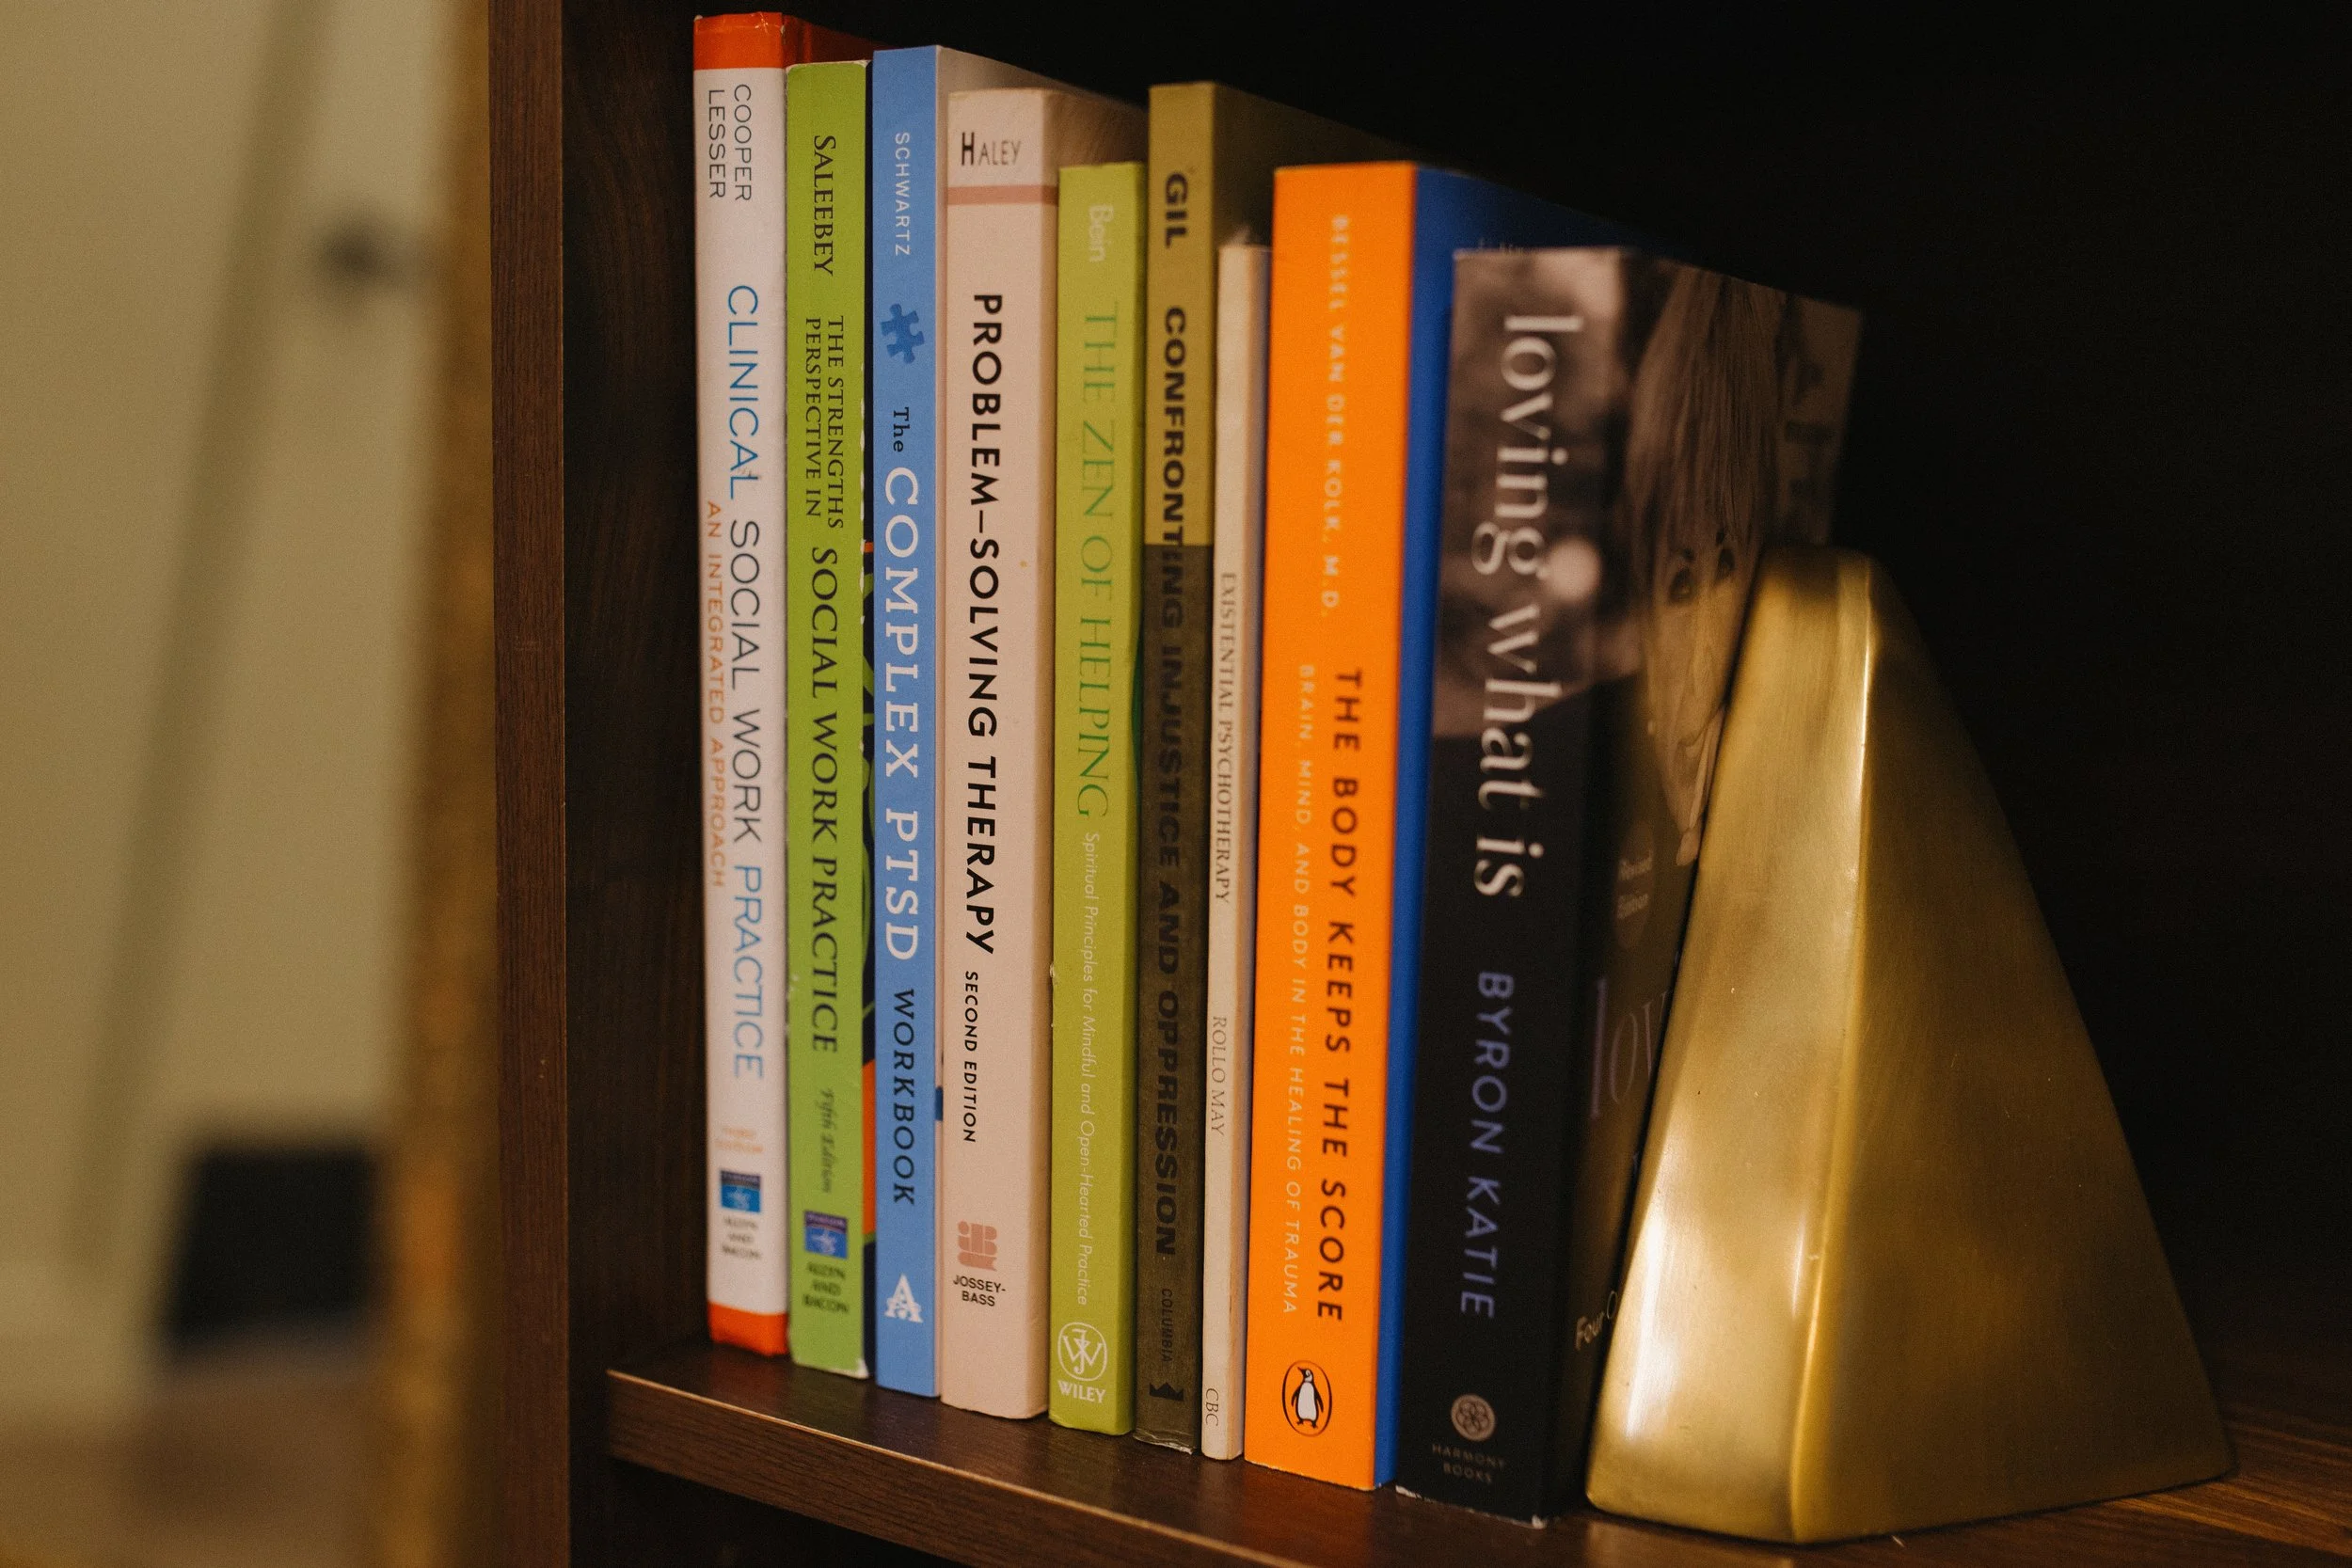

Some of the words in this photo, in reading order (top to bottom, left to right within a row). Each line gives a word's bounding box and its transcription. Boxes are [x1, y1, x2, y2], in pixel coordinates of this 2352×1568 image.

[707, 88, 726, 198] LESSER
[733, 84, 752, 201] COOPER
[961, 132, 1021, 166] HALEY
[813, 135, 835, 275] SALEEBEY
[894, 133, 912, 257] SCHWARTZ
[1089, 204, 1112, 261] Bein
[1165, 173, 1187, 246] GIL
[827, 316, 845, 365] THE
[1081, 302, 1118, 404] THE
[1327, 325, 1345, 382] VAN
[728, 285, 759, 499] CLINICAL
[805, 317, 822, 480] PERSPECTIVE
[890, 407, 911, 452] The
[1326, 395, 1343, 445] DER
[827, 376, 845, 529] STRENGTHS
[1081, 420, 1115, 517] ZEN
[1161, 308, 1186, 632] CONFRONTING
[1471, 315, 1582, 579] loving
[707, 500, 723, 538] AN
[805, 488, 822, 518] IN
[730, 519, 761, 689] SOCIAL
[1080, 535, 1113, 603] OF
[707, 554, 725, 723] INTEGRATED
[811, 546, 838, 698] SOCIAL
[884, 467, 918, 778] COMPLEX
[1219, 572, 1236, 714] EXISTENTIAL
[1077, 616, 1112, 816] HELPING
[1297, 665, 1315, 746] BRAIN,
[1334, 670, 1361, 750] THE
[1478, 604, 1562, 811] what
[733, 709, 763, 844] WORK
[812, 713, 839, 843] WORK
[1158, 644, 1184, 866] INJUSTICE
[1295, 761, 1312, 831] MIND,
[709, 737, 726, 886] APPROACH
[965, 756, 996, 954] THERAPY
[1215, 720, 1235, 903] PSYCHOTHERAPY
[1329, 778, 1359, 899] BODY
[885, 808, 918, 961] PTSD
[1082, 833, 1102, 899] Spiritual
[1295, 843, 1311, 894] AND
[1473, 835, 1544, 897] is
[733, 865, 763, 1079] PRACTICE
[812, 855, 838, 1052] PRACTICE
[1080, 907, 1100, 980] Principles
[1157, 881, 1180, 976] AND
[1293, 904, 1310, 968] BODY
[964, 971, 979, 1052] SECOND
[1082, 988, 1099, 1010] for
[1292, 978, 1308, 1004] IN
[1325, 921, 1355, 1053] KEEPS
[1081, 1015, 1097, 1078] Mindful
[1211, 1016, 1228, 1083] ROLLO
[1290, 1014, 1307, 1056] THE
[1470, 972, 1514, 1153] BYRON
[893, 989, 914, 1206] WORKBOOK
[961, 1061, 978, 1143] EDITION
[1080, 1084, 1095, 1114] and
[1156, 990, 1178, 1256] OPPRESSION
[1209, 1089, 1226, 1135] MAY
[1286, 1068, 1305, 1170] HEALING
[1322, 1078, 1350, 1156] THE
[1077, 1121, 1096, 1238] Open-Hearted
[1286, 1180, 1302, 1211] OF
[953, 1275, 1006, 1293] JOSSEY-
[1076, 1244, 1092, 1305] Practice
[1282, 1220, 1300, 1313] TRAUMA
[1316, 1179, 1346, 1321] SCORE
[1461, 1176, 1500, 1318] KATIE
[961, 1291, 995, 1307] BASS
[1161, 1288, 1175, 1365] COLUMBIA
[1057, 1381, 1106, 1404] WILEY
[1204, 1388, 1220, 1426] CBC
